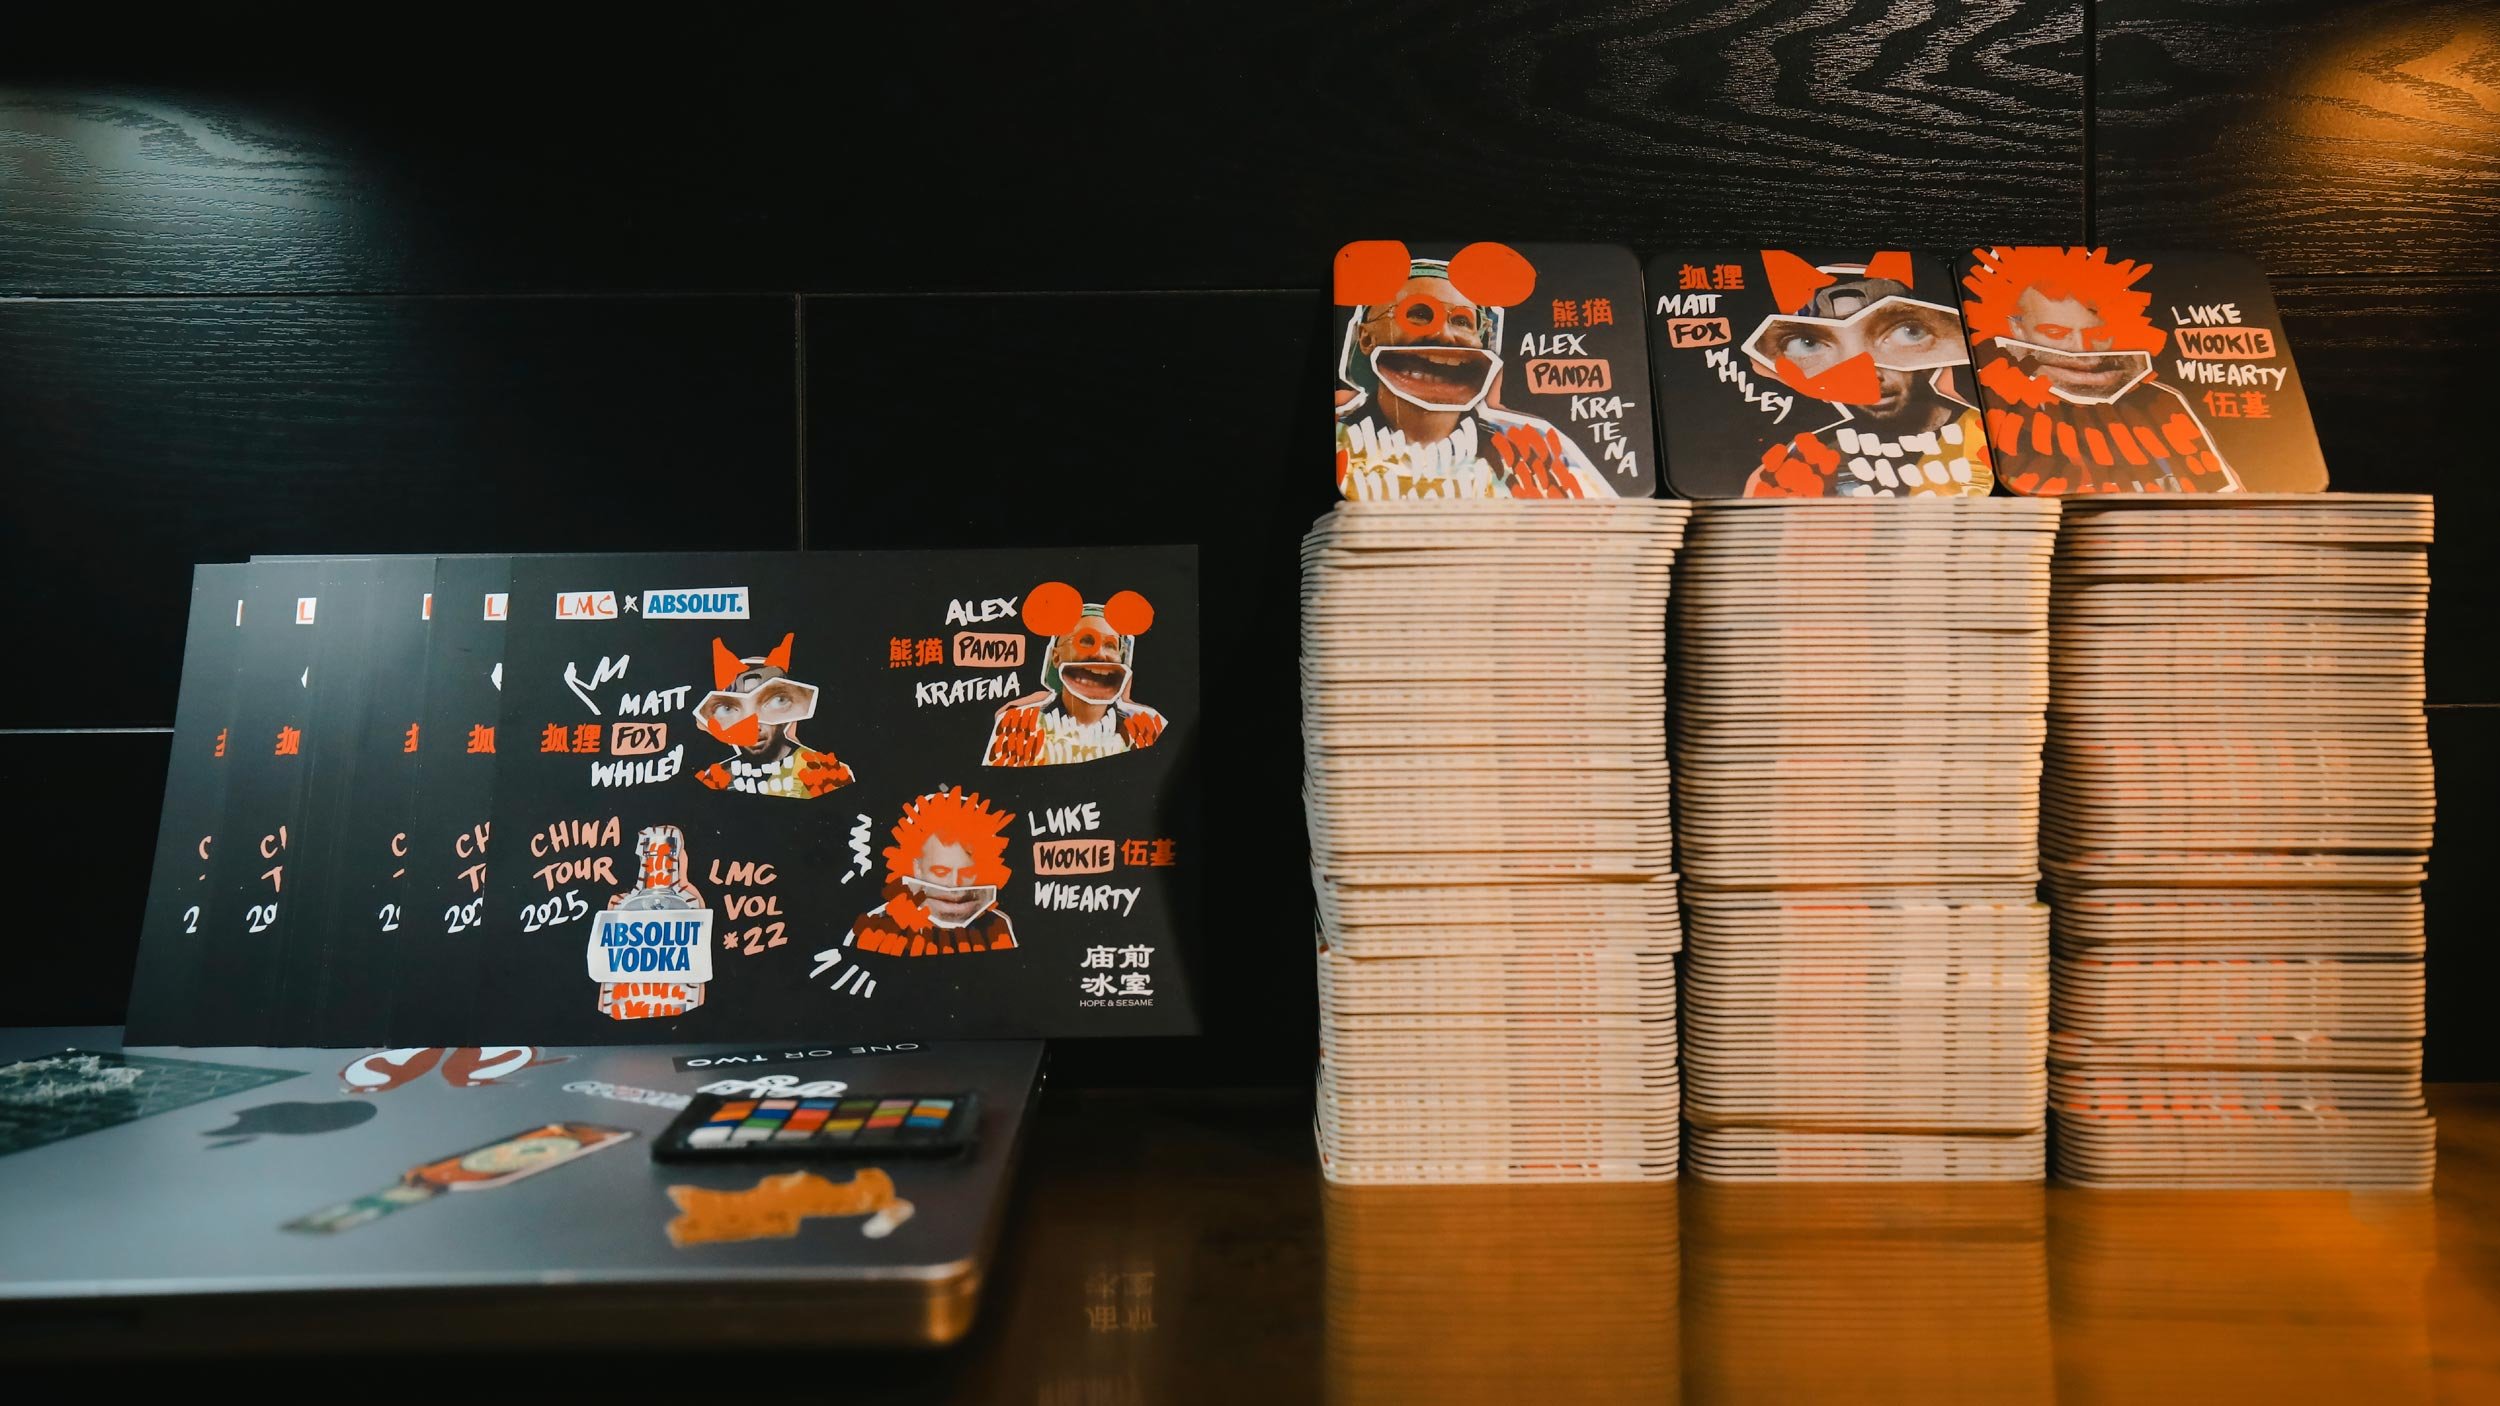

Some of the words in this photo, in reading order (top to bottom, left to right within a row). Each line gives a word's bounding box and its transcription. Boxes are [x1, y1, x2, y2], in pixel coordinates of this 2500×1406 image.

[1678, 264, 1745, 290] 狐狸
[1552, 298, 1613, 328] 熊猫
[1656, 294, 1722, 317] MATT
[2171, 303, 2241, 326] LUKE
[1519, 332, 1587, 357] ALEX
[1672, 323, 1727, 344] FOX
[2181, 331, 2270, 355] WOOKIE
[1533, 362, 1604, 388] PANDA
[1705, 348, 1793, 425] WHILEY
[2176, 359, 2287, 391] WHEARTY
[1570, 395, 1635, 422] KRA-
[558, 595, 615, 617] LMC
[945, 596, 1018, 626] ALEX
[889, 636, 943, 668] 熊猫
[958, 634, 1018, 663] PANDA
[619, 685, 692, 716] MATT
[915, 671, 1020, 707] KRATENA
[540, 723, 602, 753] 狐狸
[616, 726, 661, 749] FOX
[1028, 802, 1100, 837] LUKE
[530, 816, 621, 857] CHINA
[1039, 846, 1111, 869] WOOKIE
[533, 856, 618, 892] TOUR
[708, 859, 778, 887] LMC
[519, 889, 588, 932] 2025
[723, 894, 783, 921] VOL
[1034, 881, 1140, 917] WHEARTY
[600, 921, 702, 948] ABSOLUT
[608, 947, 690, 972] VODKA
[1080, 944, 1155, 969] 庙前
[1080, 972, 1154, 997] 冰室
[1079, 999, 1106, 1008] HOPE
[1107, 999, 1114, 1007] &
[1115, 998, 1154, 1007] SESAME
[687, 1054, 768, 1067] TWO
[850, 1043, 919, 1055] ONE
